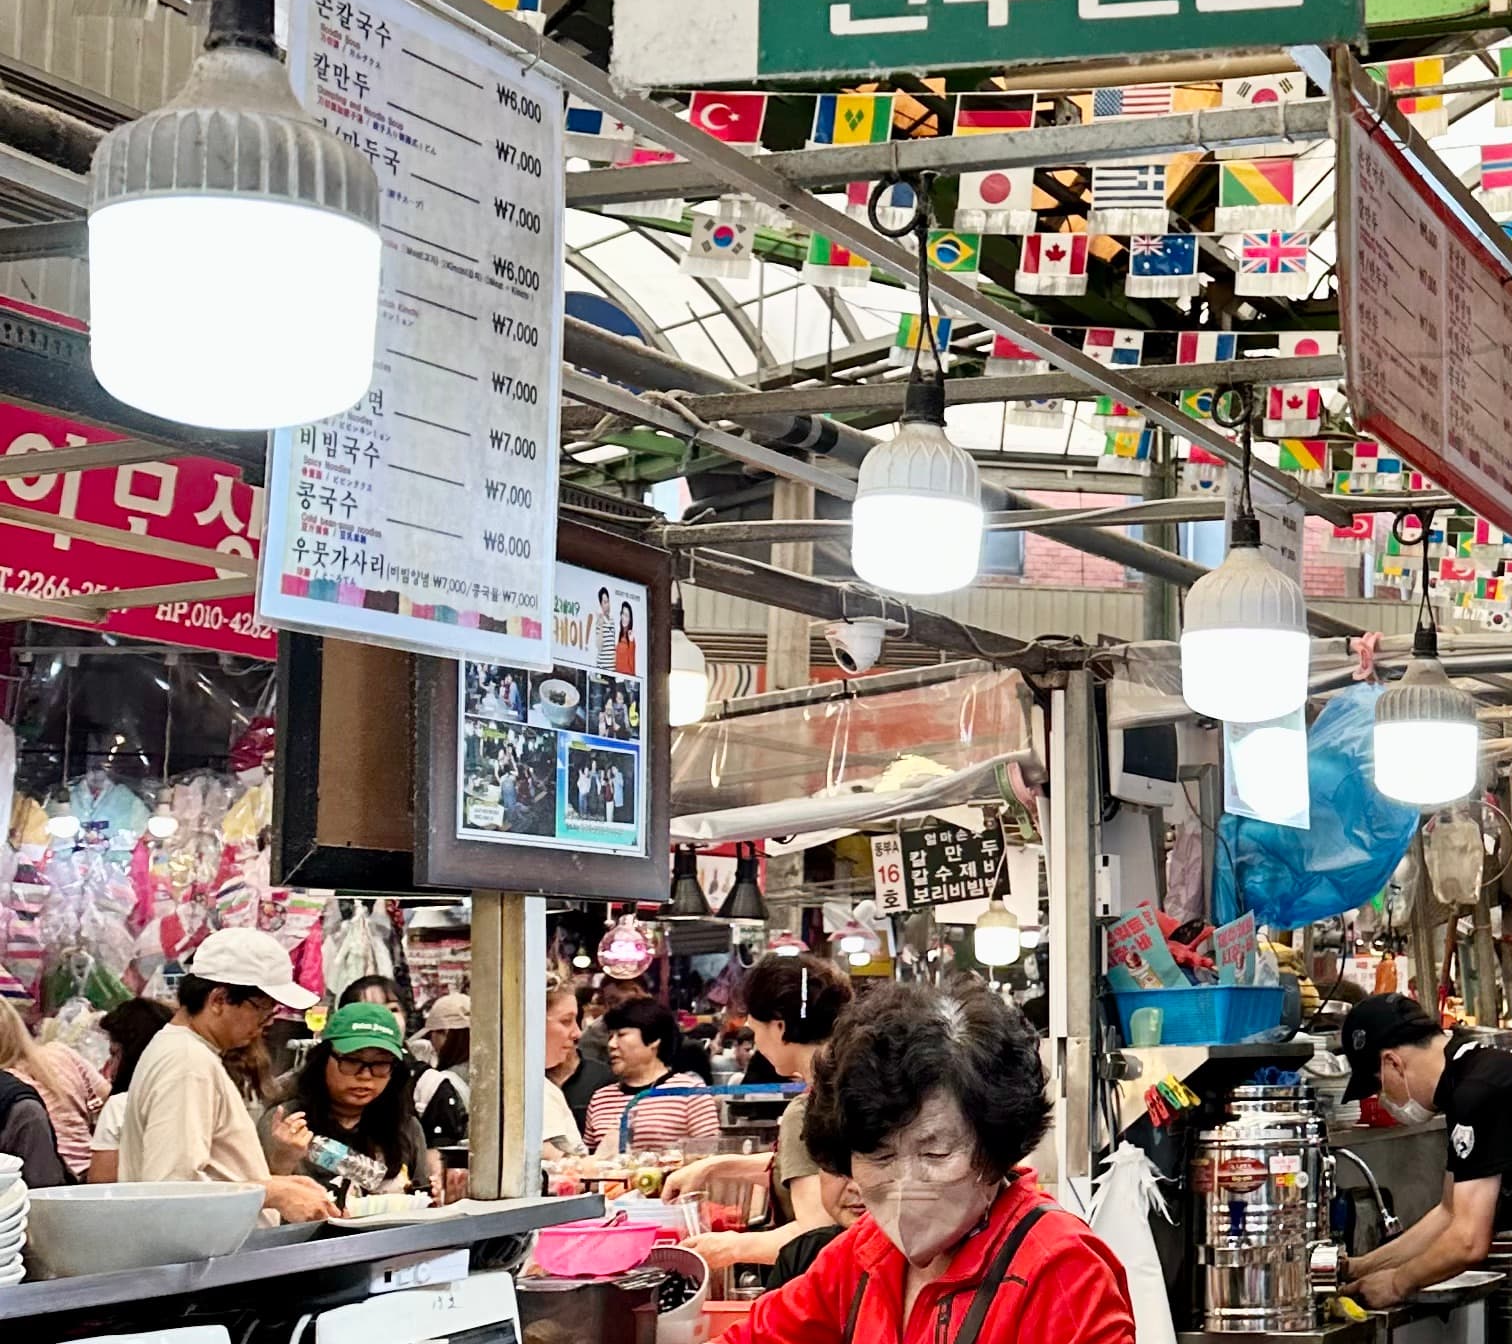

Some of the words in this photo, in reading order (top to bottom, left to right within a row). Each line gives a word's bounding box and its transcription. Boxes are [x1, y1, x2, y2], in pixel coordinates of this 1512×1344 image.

[313, 52, 371, 100] 칼만두
[495, 139, 542, 178] ₩7,000
[496, 83, 542, 125] ₩6,000
[494, 196, 541, 234] ₩7,000
[492, 252, 540, 291] ₩6,000
[491, 311, 539, 348] ₩7,000
[491, 371, 538, 406] ₩7,000
[489, 428, 537, 460] ₩7,000
[300, 425, 380, 469] 비빔국수
[484, 478, 532, 509] ₩7,000
[296, 480, 359, 519] 콩국수
[483, 530, 531, 559] ₩8,000
[292, 537, 384, 580] 우뭇가사리
[877, 863, 900, 884] 16
[883, 889, 901, 909] 호
